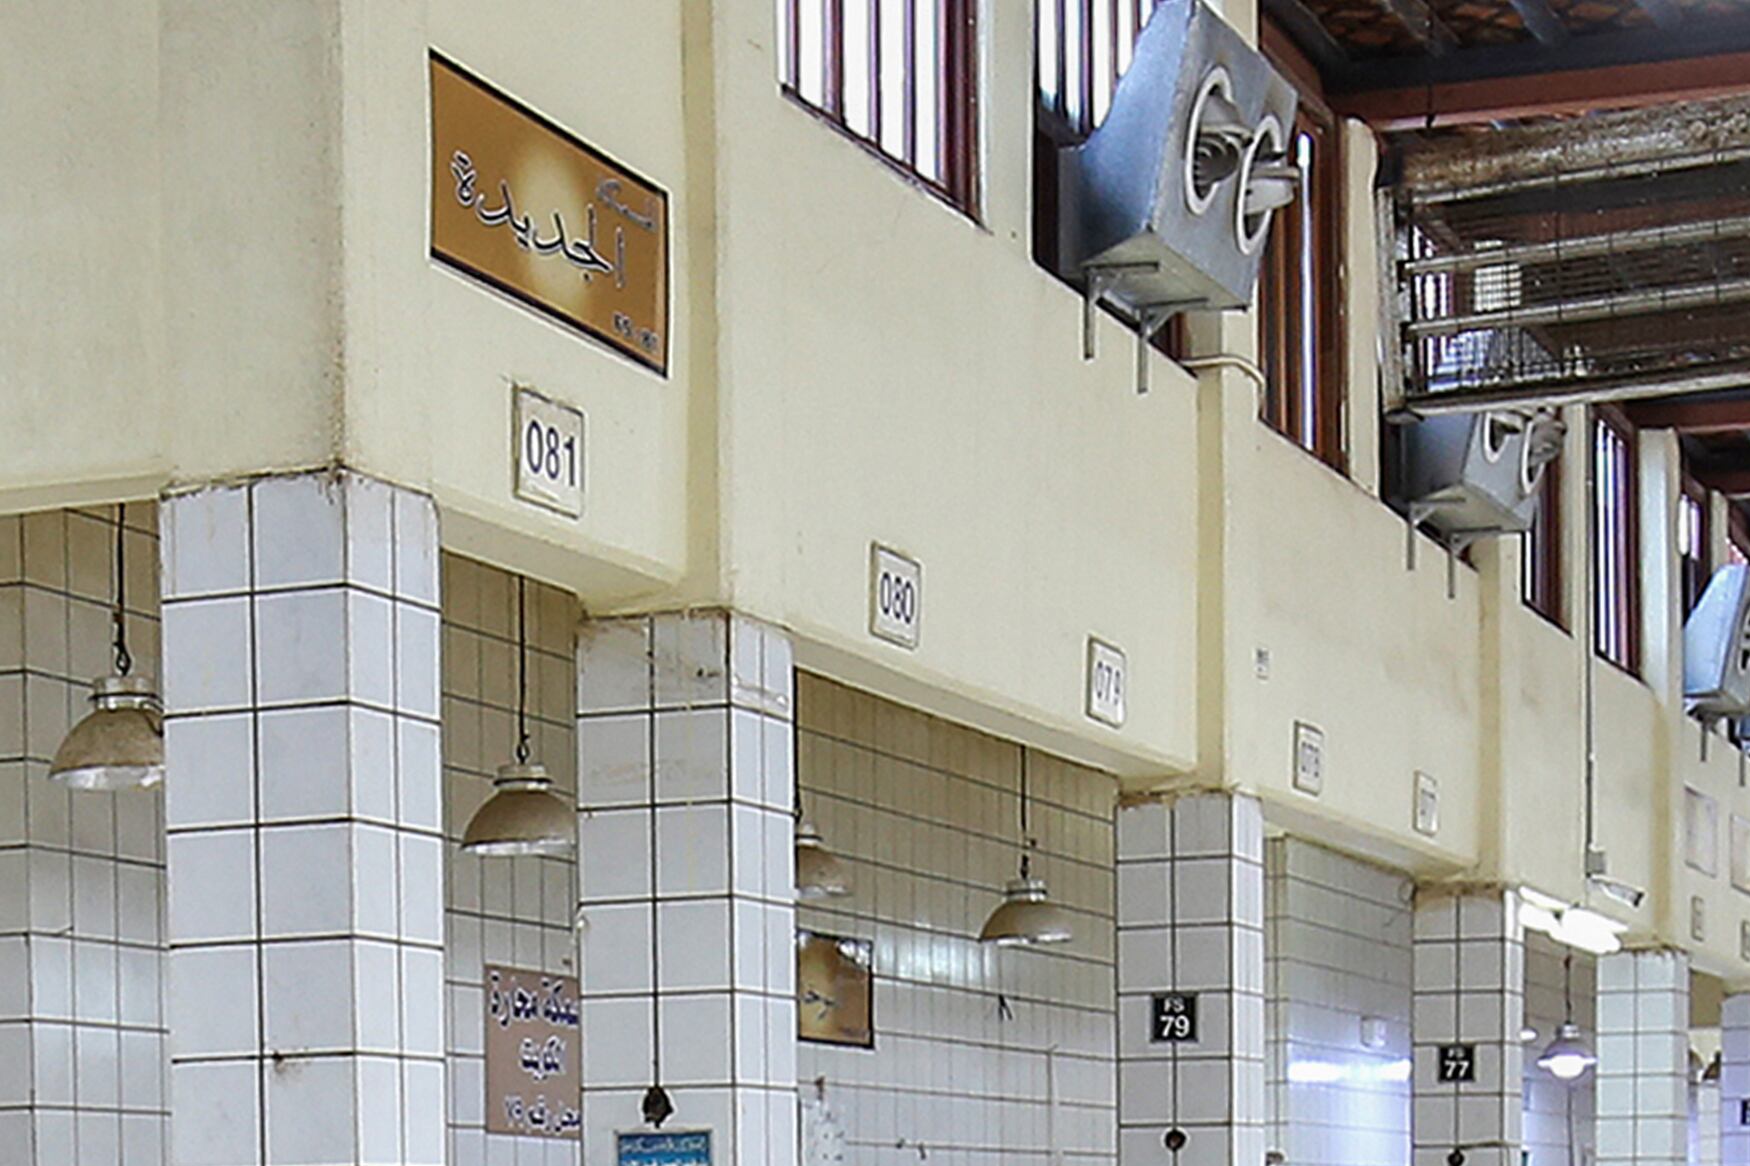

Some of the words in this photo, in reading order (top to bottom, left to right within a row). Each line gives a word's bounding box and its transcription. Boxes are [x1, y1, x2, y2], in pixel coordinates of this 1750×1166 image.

[452, 151, 624, 288] الجديدة
[526, 418, 575, 487] 081
[880, 571, 915, 624] 080
[1095, 660, 1120, 706] 079
[1160, 1015, 1190, 1037] 79
[1444, 1060, 1469, 1077] 77
